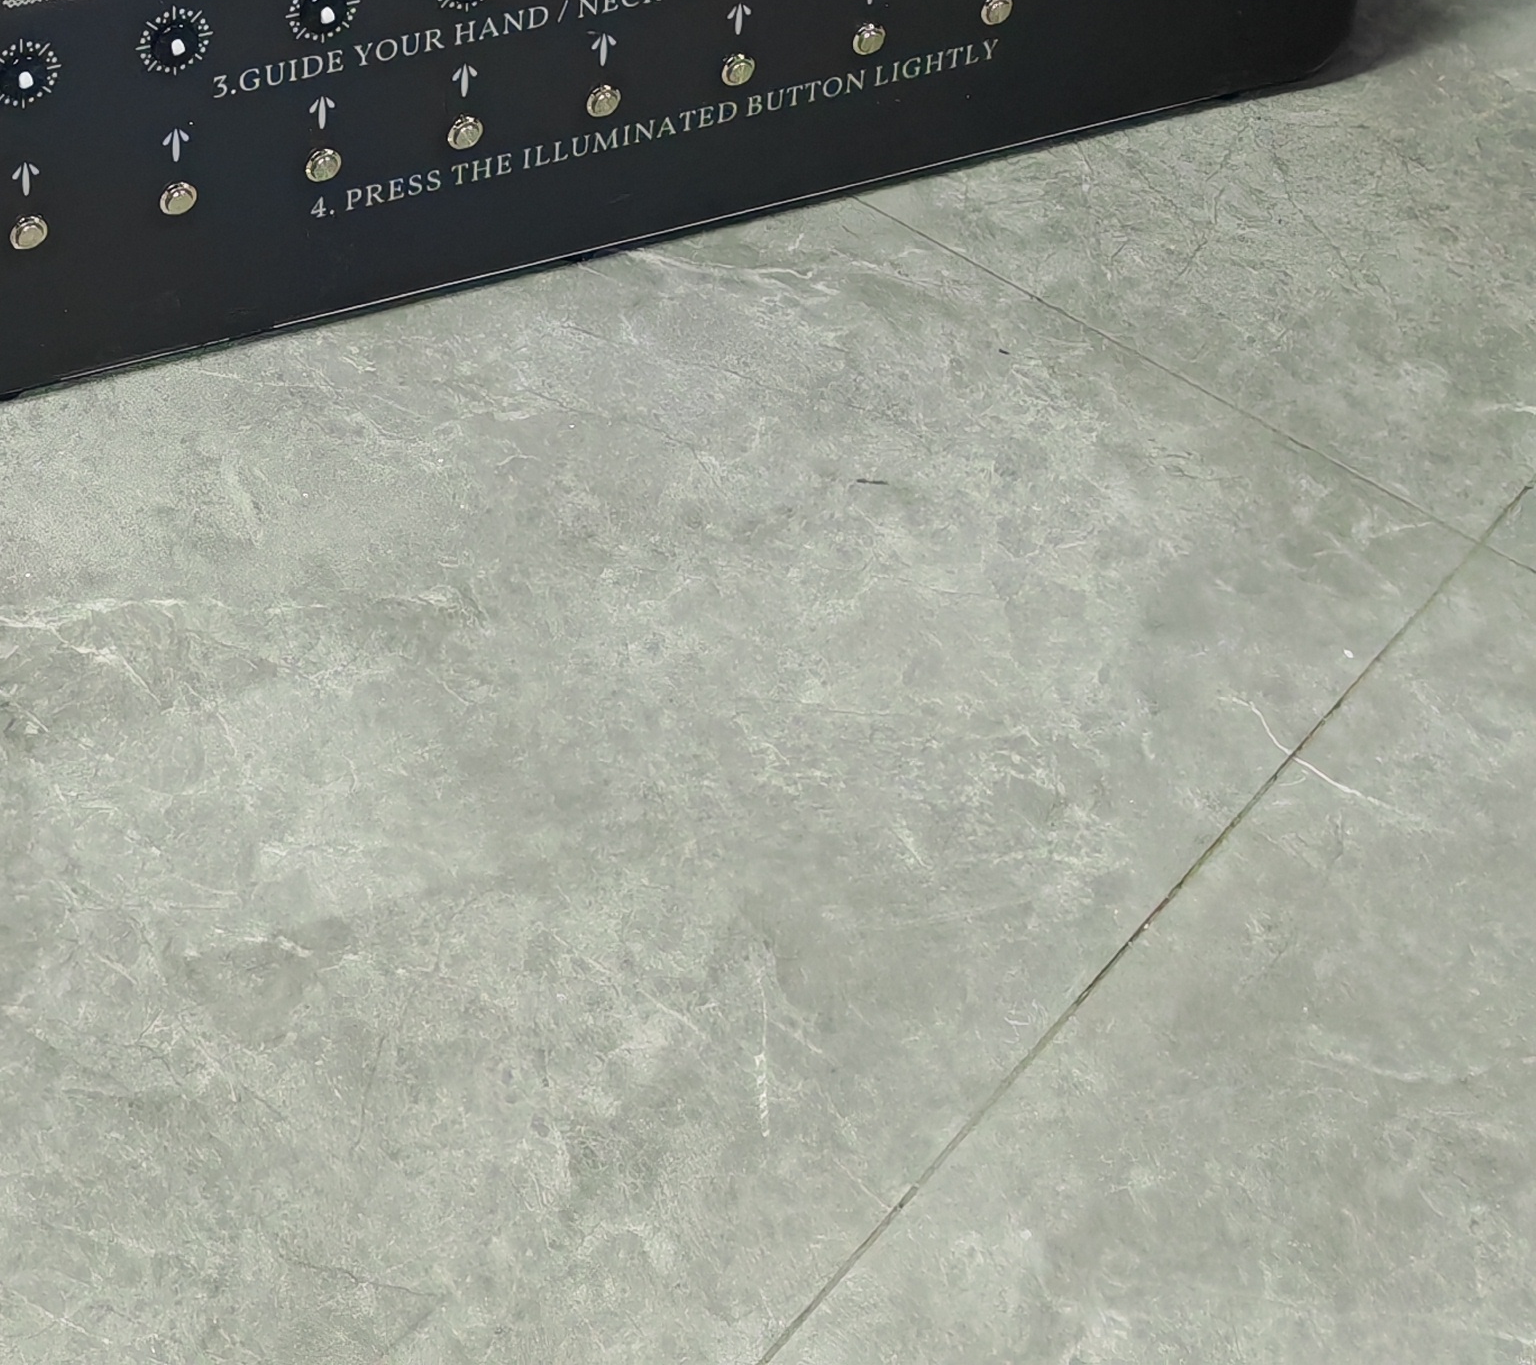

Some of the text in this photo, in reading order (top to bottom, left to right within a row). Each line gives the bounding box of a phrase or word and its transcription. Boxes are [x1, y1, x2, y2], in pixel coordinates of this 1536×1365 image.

[212, 50, 345, 99] 3.GUIDE
[352, 28, 446, 67] YOUR
[454, 5, 550, 46] HAND
[309, 38, 999, 219] 4. PRESS THE ILLUMINATED BUTTON LIGHTLY
